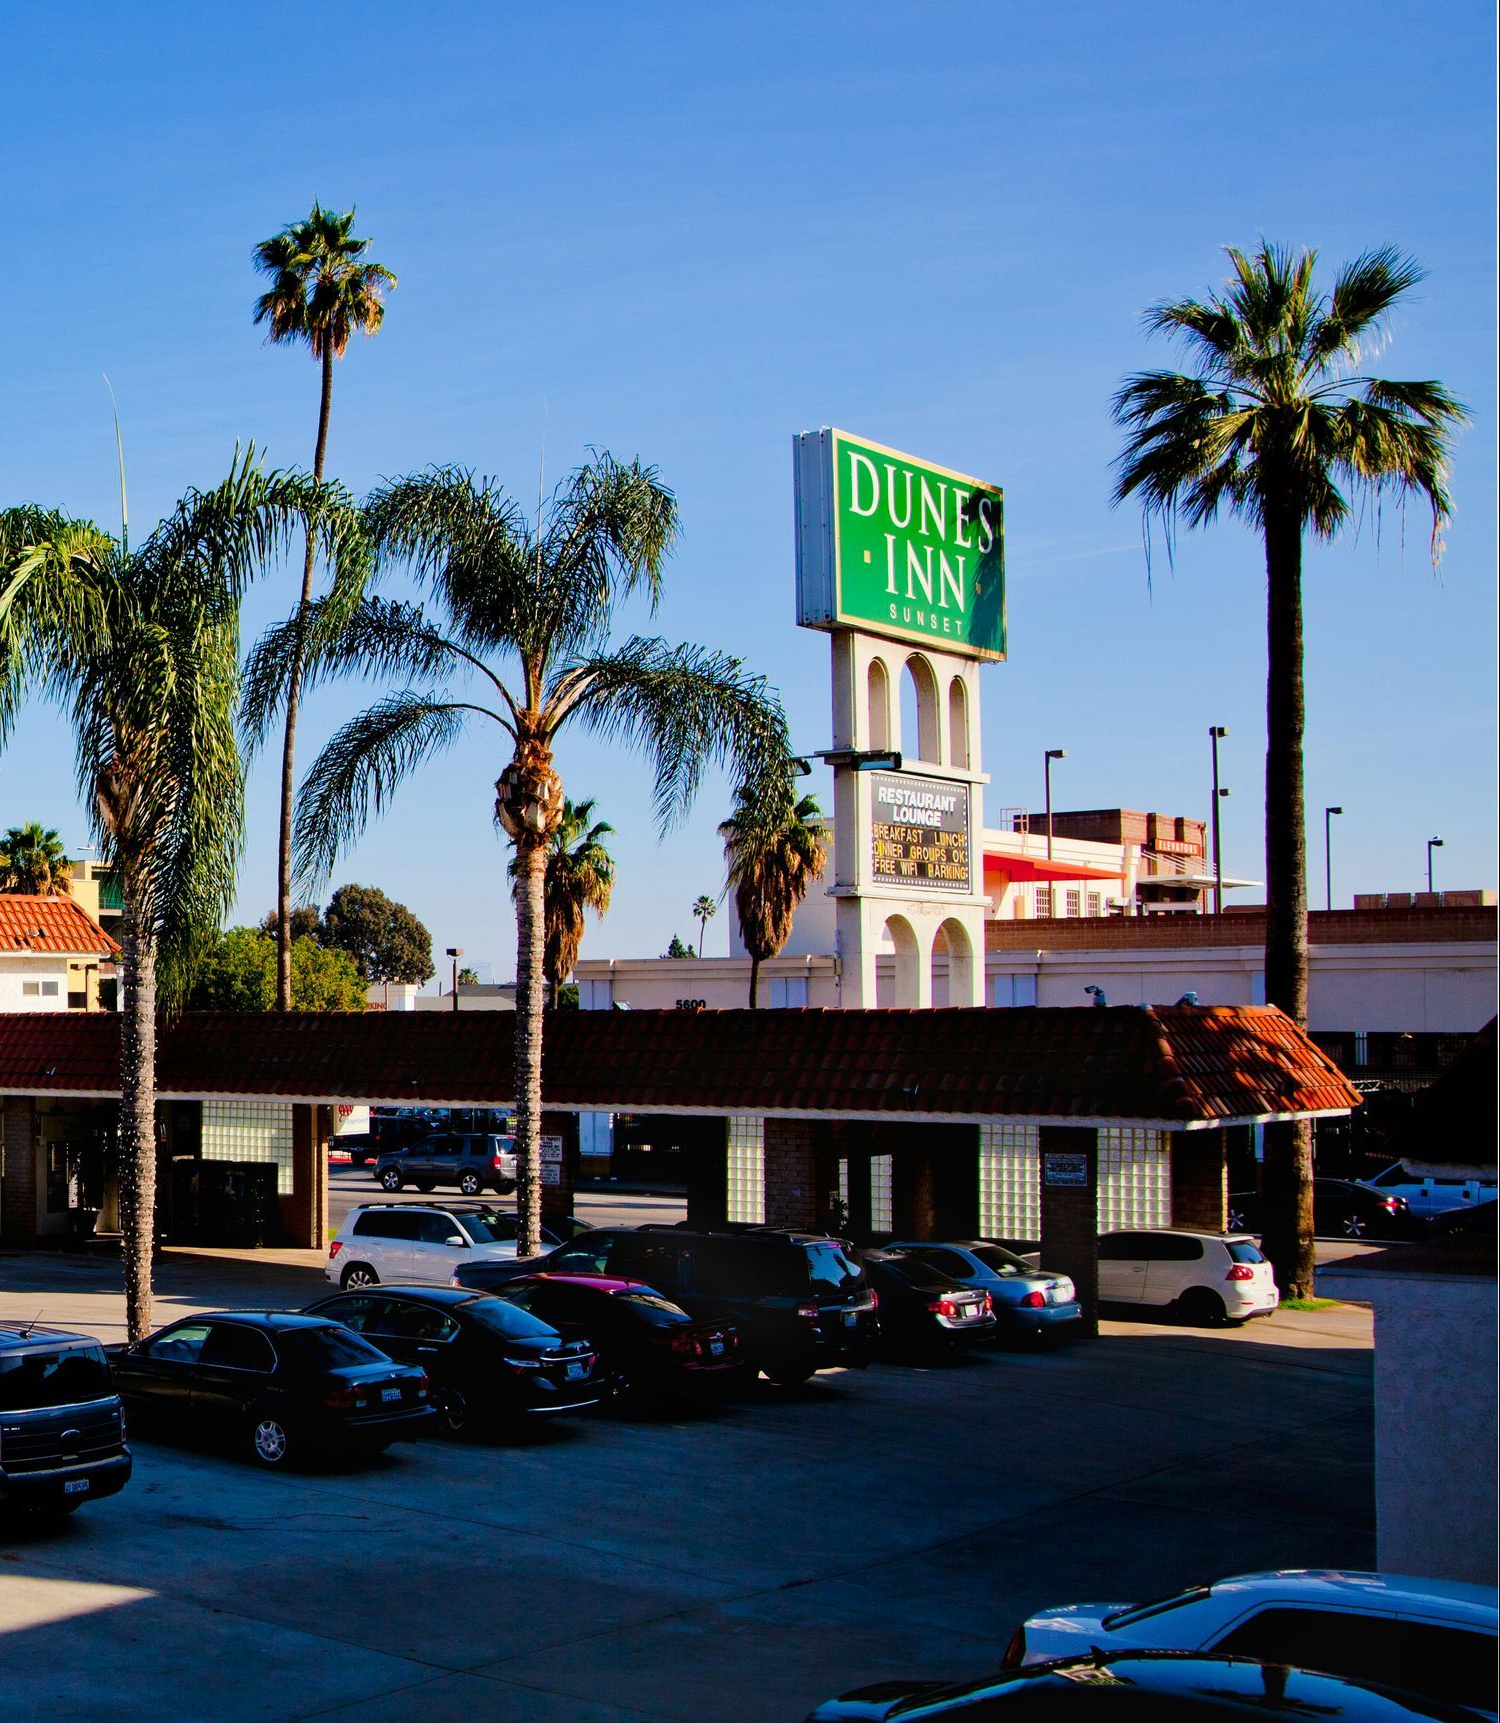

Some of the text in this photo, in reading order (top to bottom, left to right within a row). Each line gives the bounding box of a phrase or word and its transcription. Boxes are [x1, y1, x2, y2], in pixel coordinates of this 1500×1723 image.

[847, 451, 994, 554] DUNES
[884, 533, 966, 613] INN
[890, 603, 962, 636] SUNSET
[878, 786, 956, 812] RESTAURANT
[893, 806, 942, 827] LOUNGE
[873, 823, 965, 847] BREAKFAST LUNCH
[874, 840, 965, 863] DINNER GROUPS OK
[1159, 840, 1197, 854] ELEVATORS
[874, 859, 966, 880] FREE WIFI PARKING
[676, 999, 706, 1010] 5600
